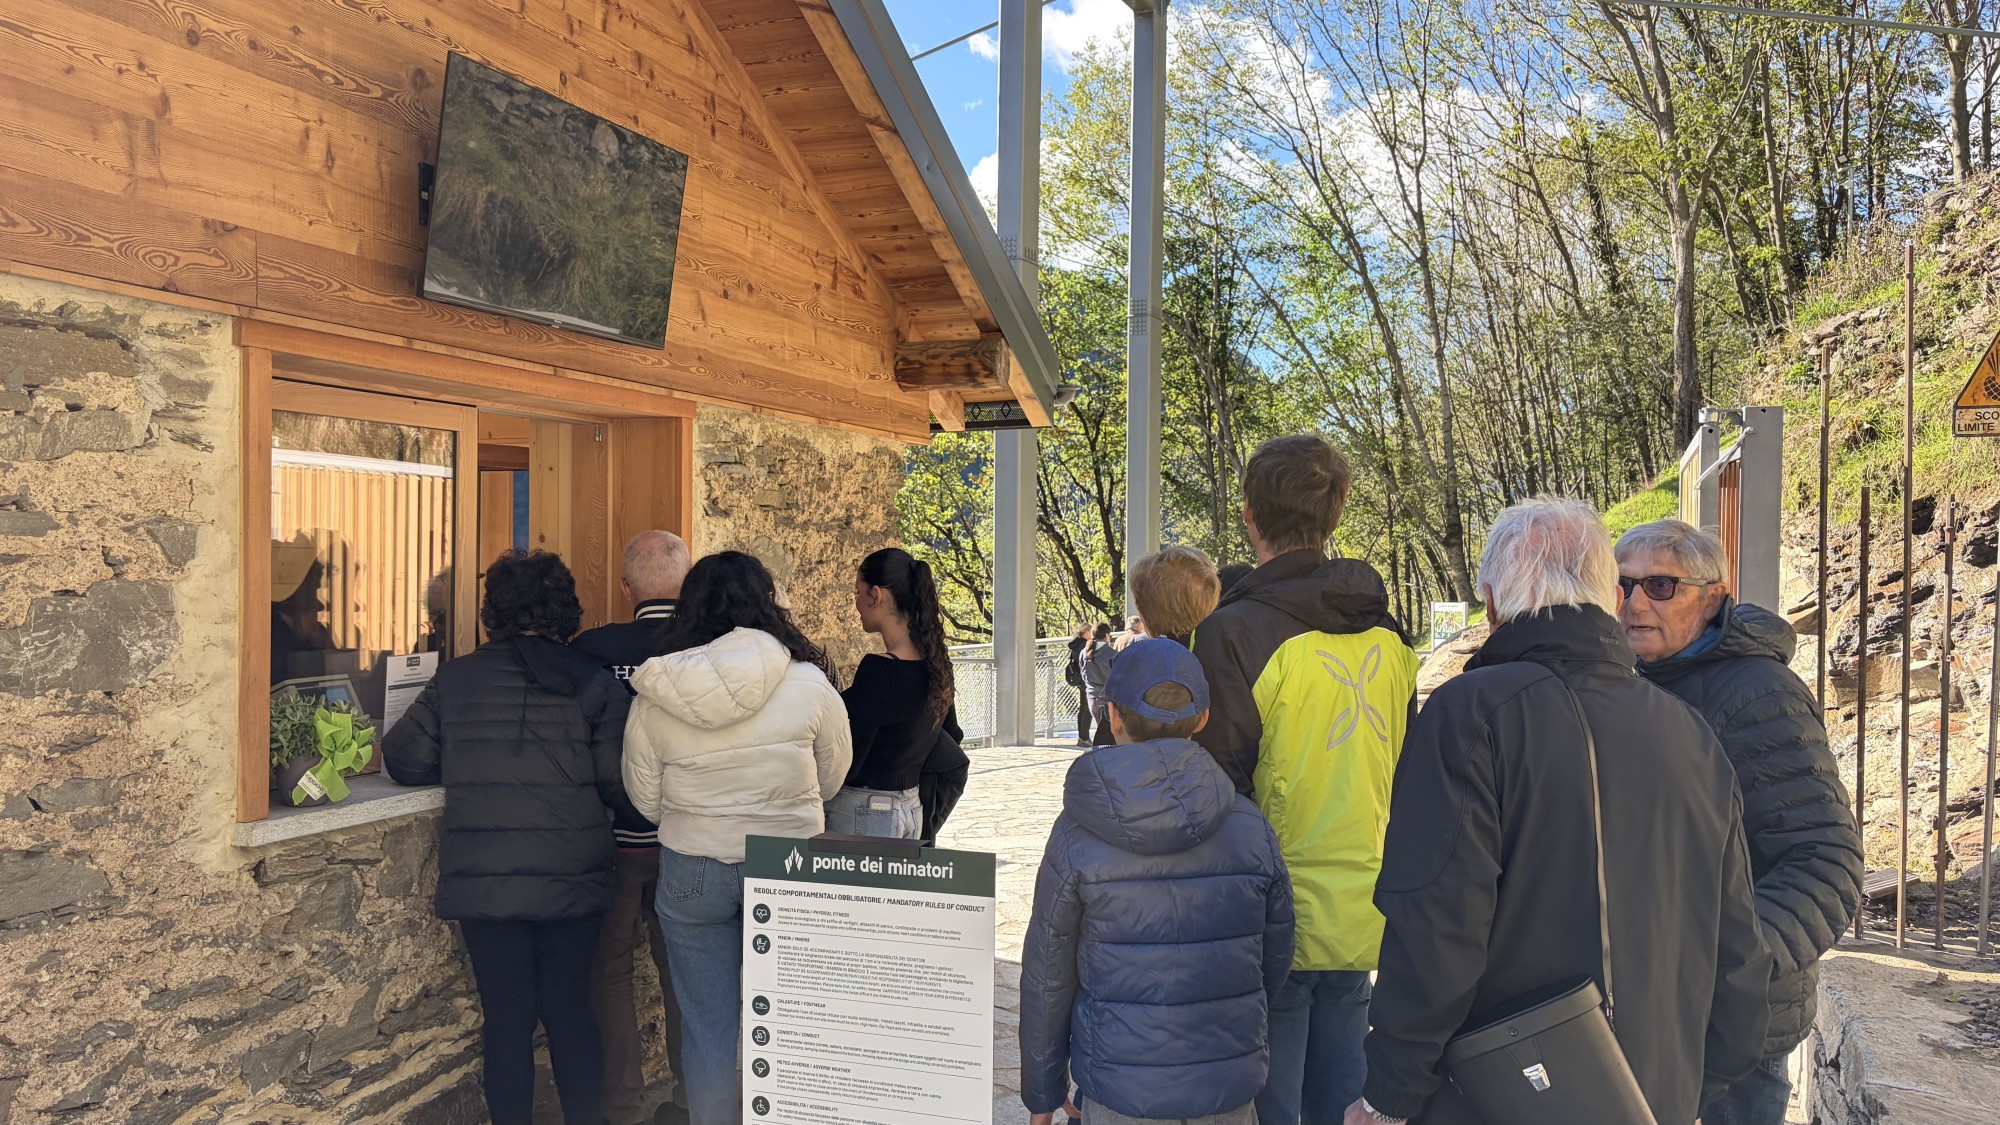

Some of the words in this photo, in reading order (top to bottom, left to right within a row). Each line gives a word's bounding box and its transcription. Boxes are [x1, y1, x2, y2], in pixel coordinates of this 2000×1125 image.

[1957, 422, 1994, 432] LIMITE
[812, 856, 856, 873] ponte
[860, 856, 883, 874] dei
[888, 858, 954, 879] minatori
[754, 887, 777, 895] REGOLE
[778, 889, 837, 900] COMPORTAMENTALI
[838, 894, 882, 904] OBBLIGATORIE
[887, 898, 924, 907] MANDATORY
[925, 901, 945, 909] RULES
[955, 904, 985, 913] CONDUCT
